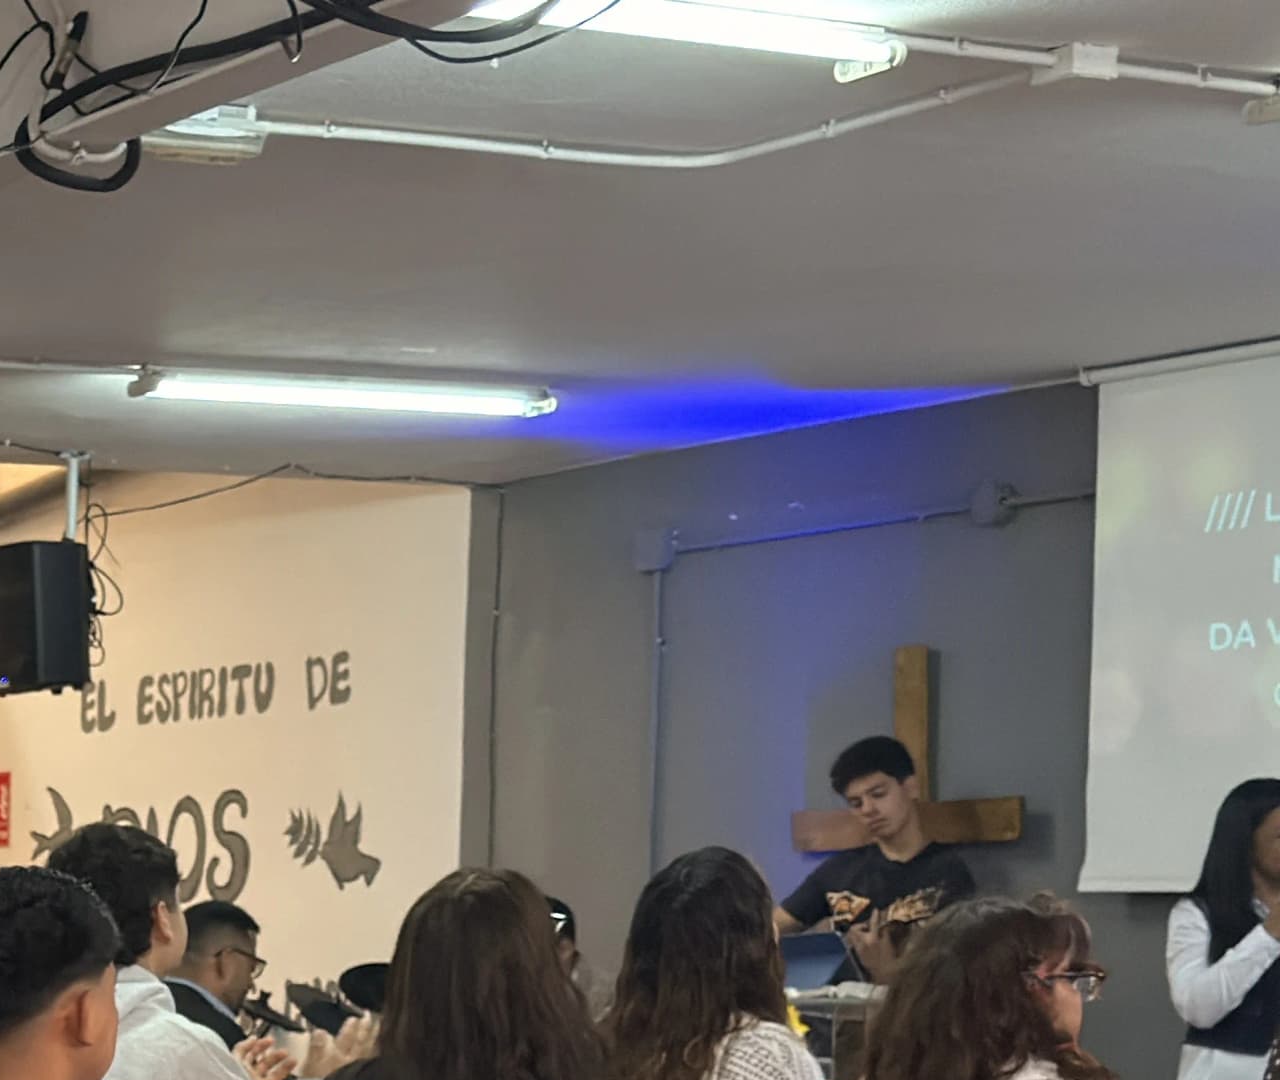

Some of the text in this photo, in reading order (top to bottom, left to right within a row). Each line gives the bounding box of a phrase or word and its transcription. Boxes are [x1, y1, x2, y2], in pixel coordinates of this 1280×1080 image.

[1209, 620, 1256, 650] DA
[81, 651, 351, 734] EL ESPIRITU DE
[101, 789, 251, 904] OS
